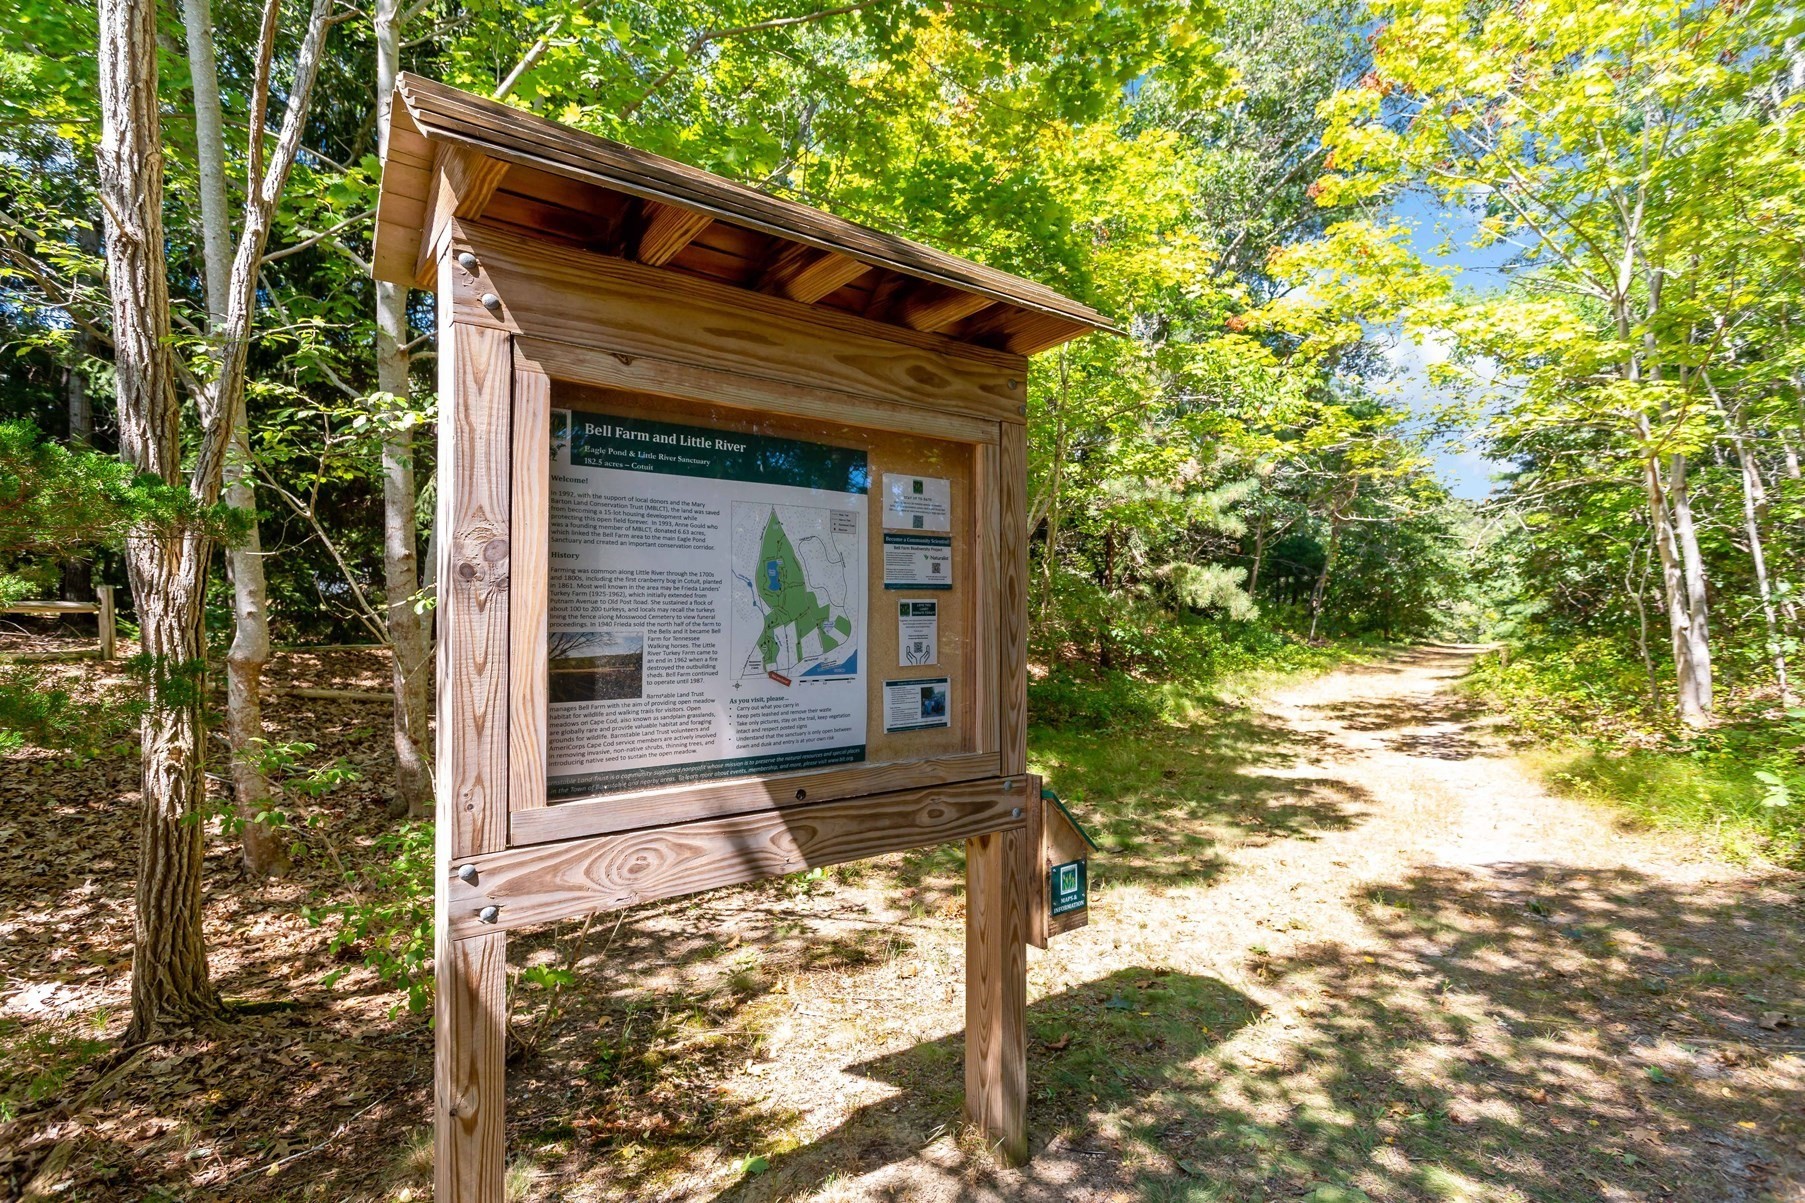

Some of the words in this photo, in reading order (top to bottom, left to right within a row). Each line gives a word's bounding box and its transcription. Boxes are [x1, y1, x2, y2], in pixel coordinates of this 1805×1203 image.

[585, 423, 611, 437] Bell
[615, 427, 649, 442] Farm
[653, 433, 677, 445] and
[680, 434, 712, 449] Little
[715, 438, 745, 452] River
[585, 447, 607, 455] Eagle
[677, 455, 710, 466] Sanctuary
[631, 463, 654, 471] Cotuit
[588, 500, 628, 509] Conservation
[618, 568, 635, 577] along
[666, 569, 688, 578] through
[560, 727, 585, 736] globally
[611, 724, 634, 732] provide
[550, 736, 575, 745] grounds
[610, 731, 640, 739] Barnstable
[1054, 900, 1084, 914] INFORMATION
